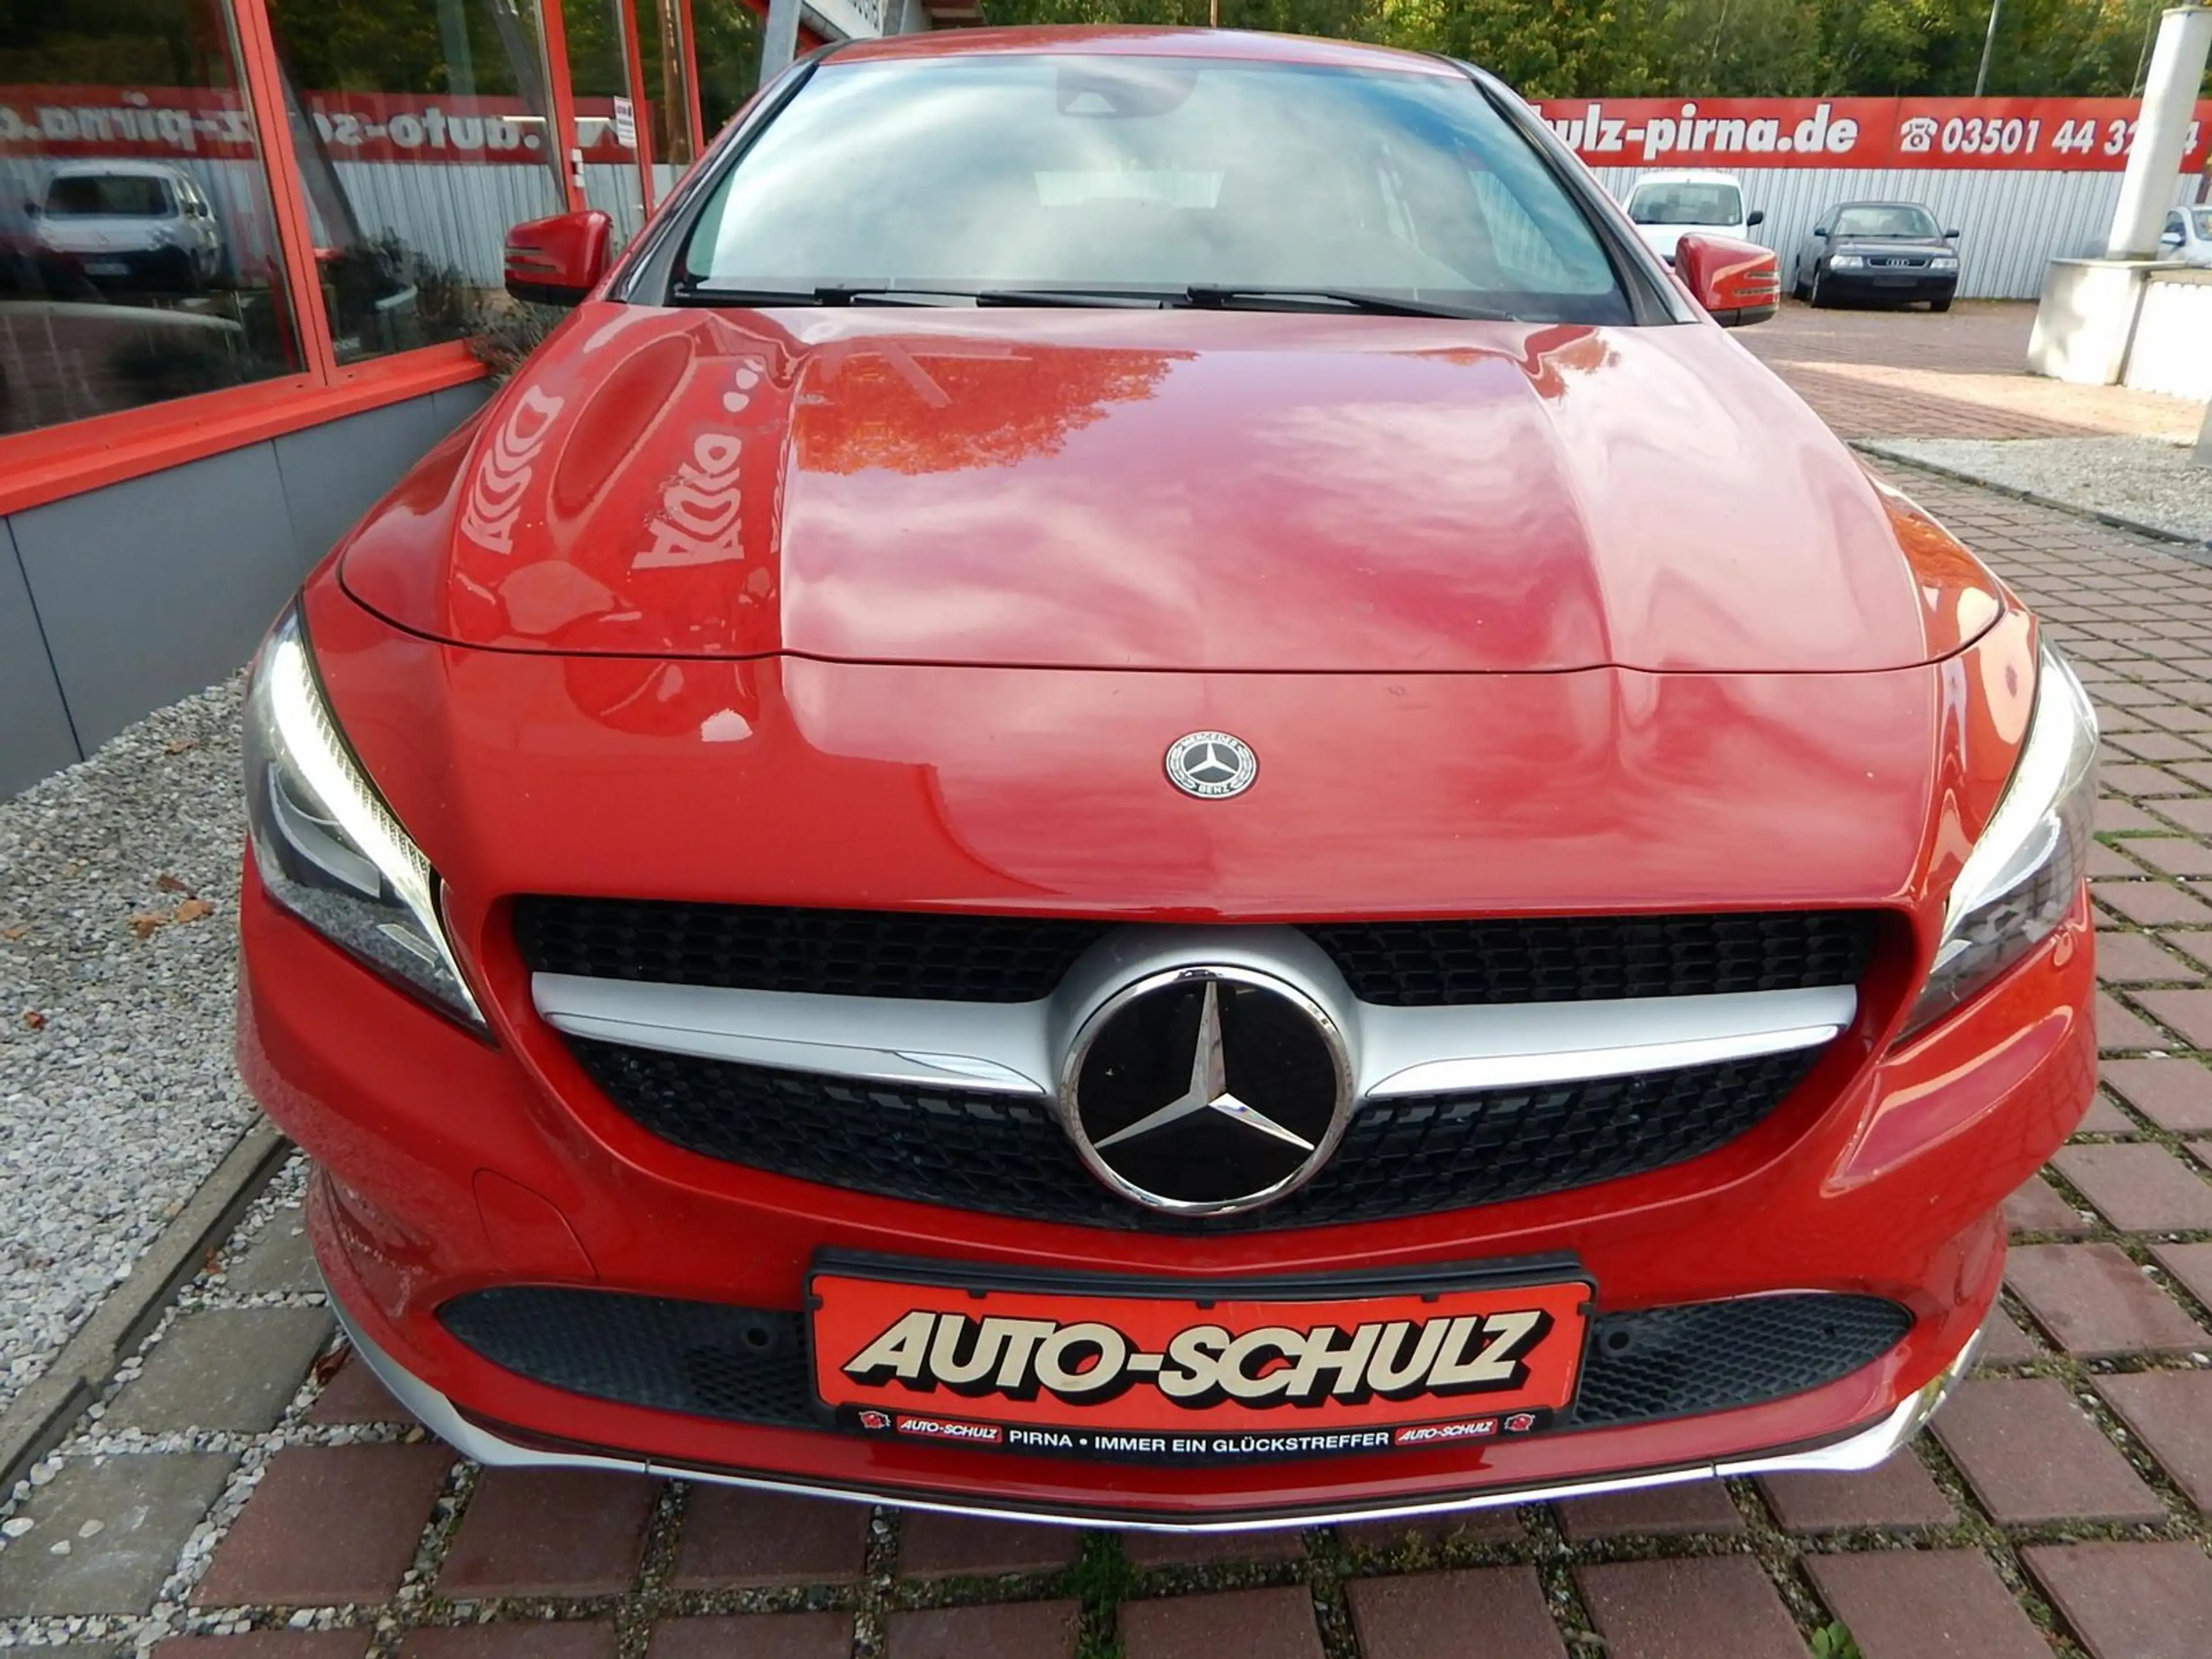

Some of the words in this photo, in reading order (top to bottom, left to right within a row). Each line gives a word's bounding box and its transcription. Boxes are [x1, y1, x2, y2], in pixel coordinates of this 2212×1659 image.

[1941, 118, 2041, 154] 03501
[2051, 120, 2095, 154] 44
[843, 1309, 1541, 1398] AUTO-SCHULZ
[901, 1418, 998, 1439] AUTO-SCHULZ
[1009, 1430, 1073, 1448] PIRNA
[1094, 1436, 1166, 1452] IMMER
[1172, 1438, 1207, 1453] EIN
[1213, 1432, 1389, 1453] GLÜCKSTREFFER
[1398, 1420, 1494, 1441] AUTO-SCHULZ
